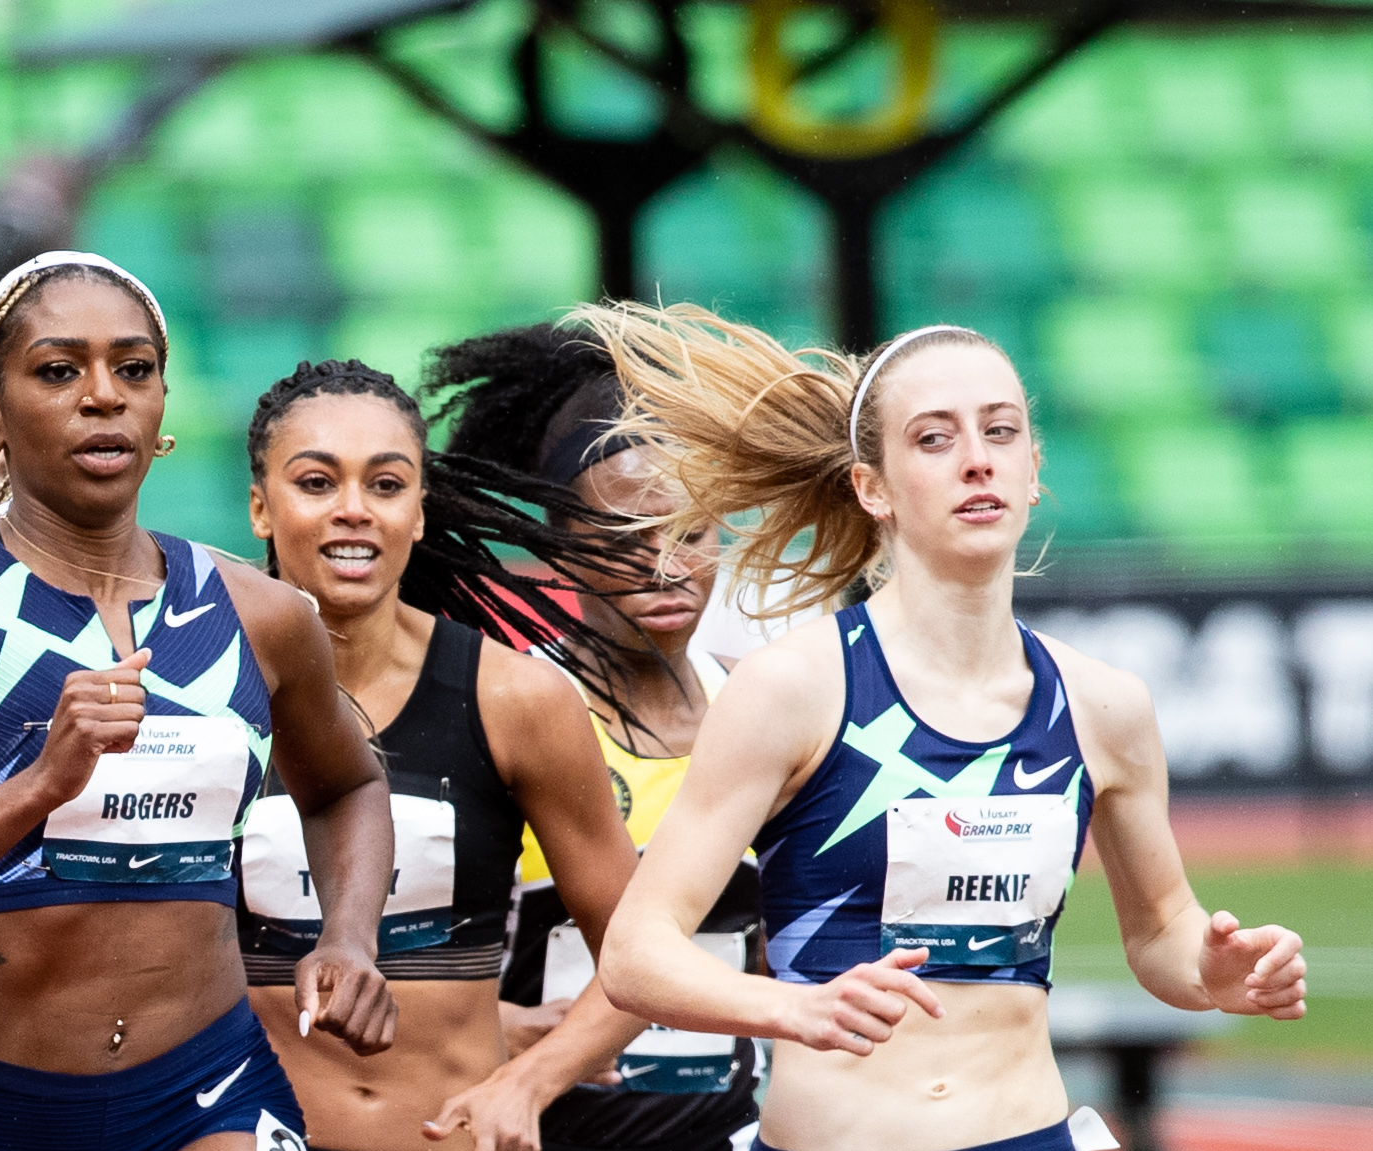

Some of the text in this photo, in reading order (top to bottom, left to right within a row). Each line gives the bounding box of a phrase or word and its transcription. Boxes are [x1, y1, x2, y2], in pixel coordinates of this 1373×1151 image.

[130, 744, 196, 754] RAND PRIX
[101, 793, 197, 820] ROGERS
[962, 823, 1032, 836] GRAND PRIX
[55, 853, 116, 864] TRACKTOWN, USA
[389, 926, 407, 935] APRIL
[895, 937, 956, 946] TRACKTOWN, USA
